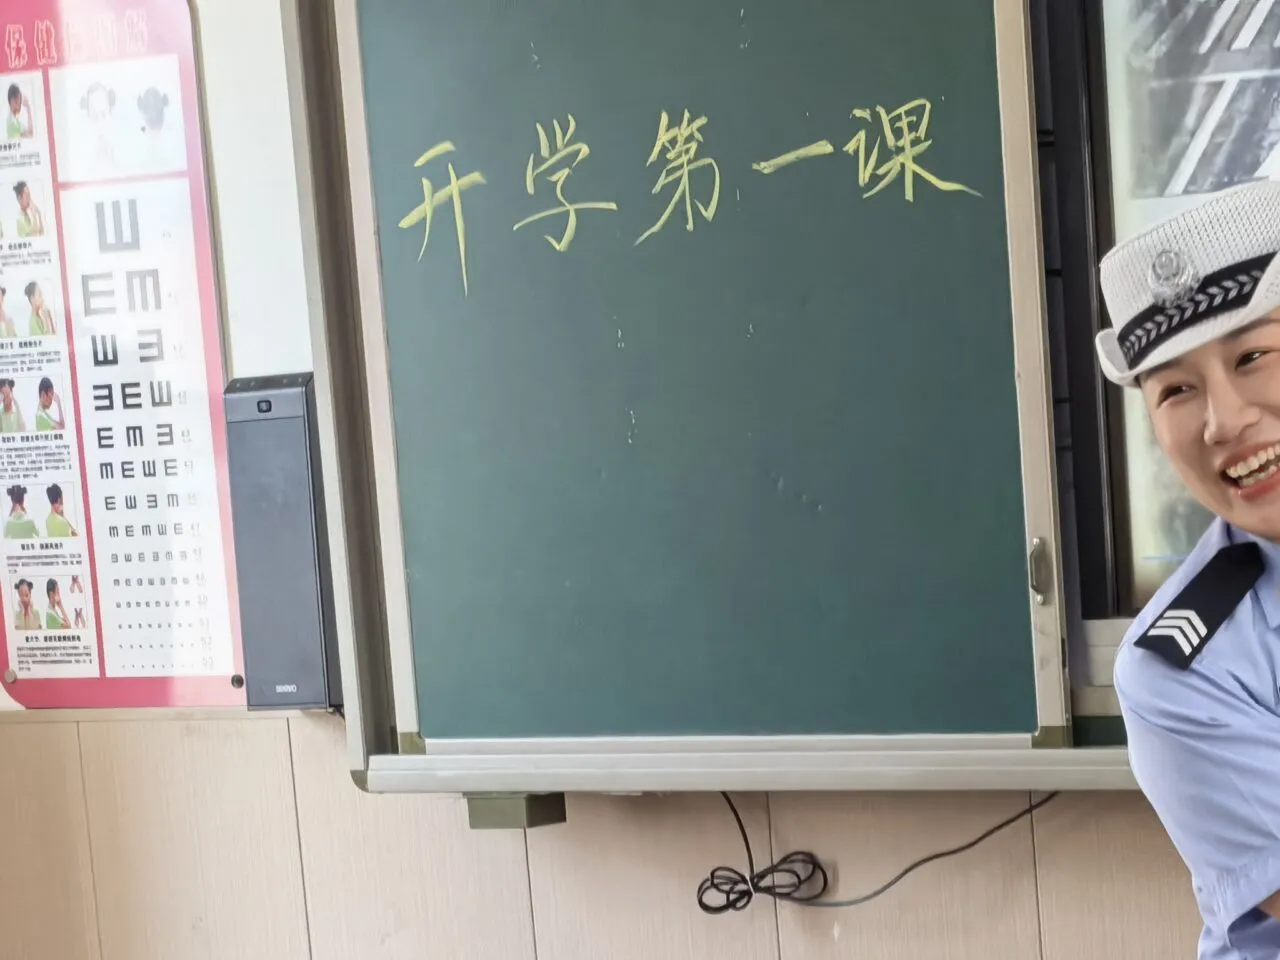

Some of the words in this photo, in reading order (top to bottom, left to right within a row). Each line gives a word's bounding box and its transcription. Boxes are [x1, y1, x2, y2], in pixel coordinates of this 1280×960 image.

[398, 98, 984, 297] 开学第一课
